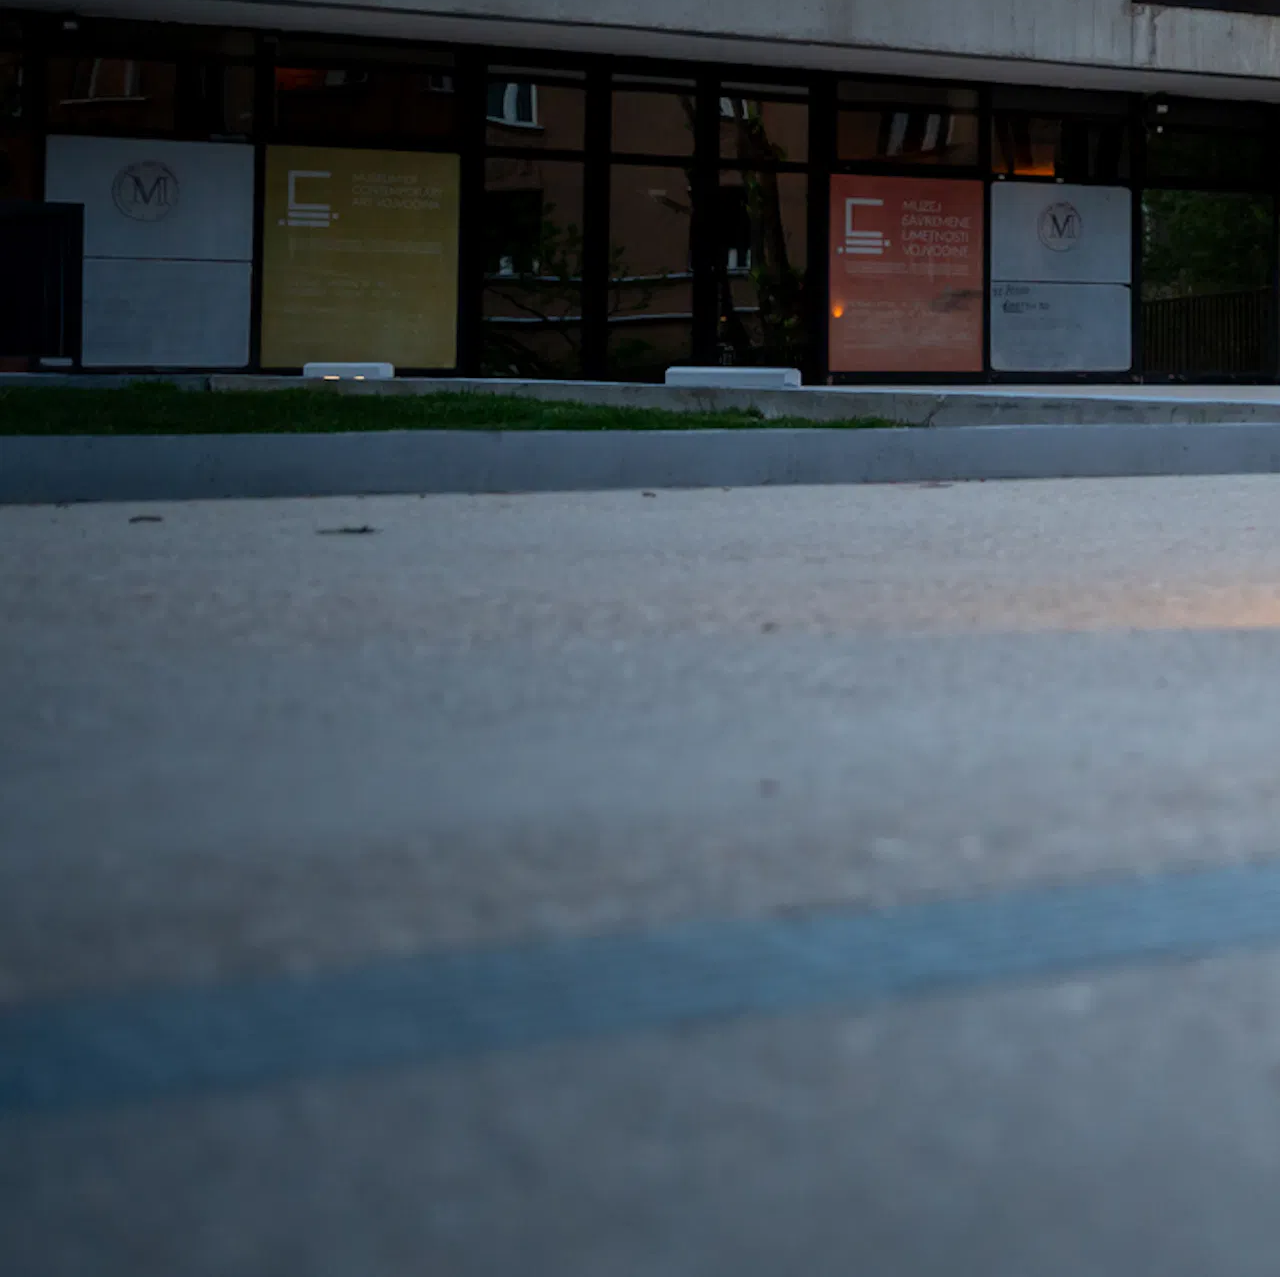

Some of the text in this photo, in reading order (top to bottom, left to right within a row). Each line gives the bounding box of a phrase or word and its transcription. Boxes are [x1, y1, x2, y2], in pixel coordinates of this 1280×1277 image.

[902, 200, 942, 213] MUZEJ
[901, 213, 972, 229] SAVREMENE
[901, 229, 969, 243] UMETNOSTI
[902, 244, 969, 260] VOJVODINE
